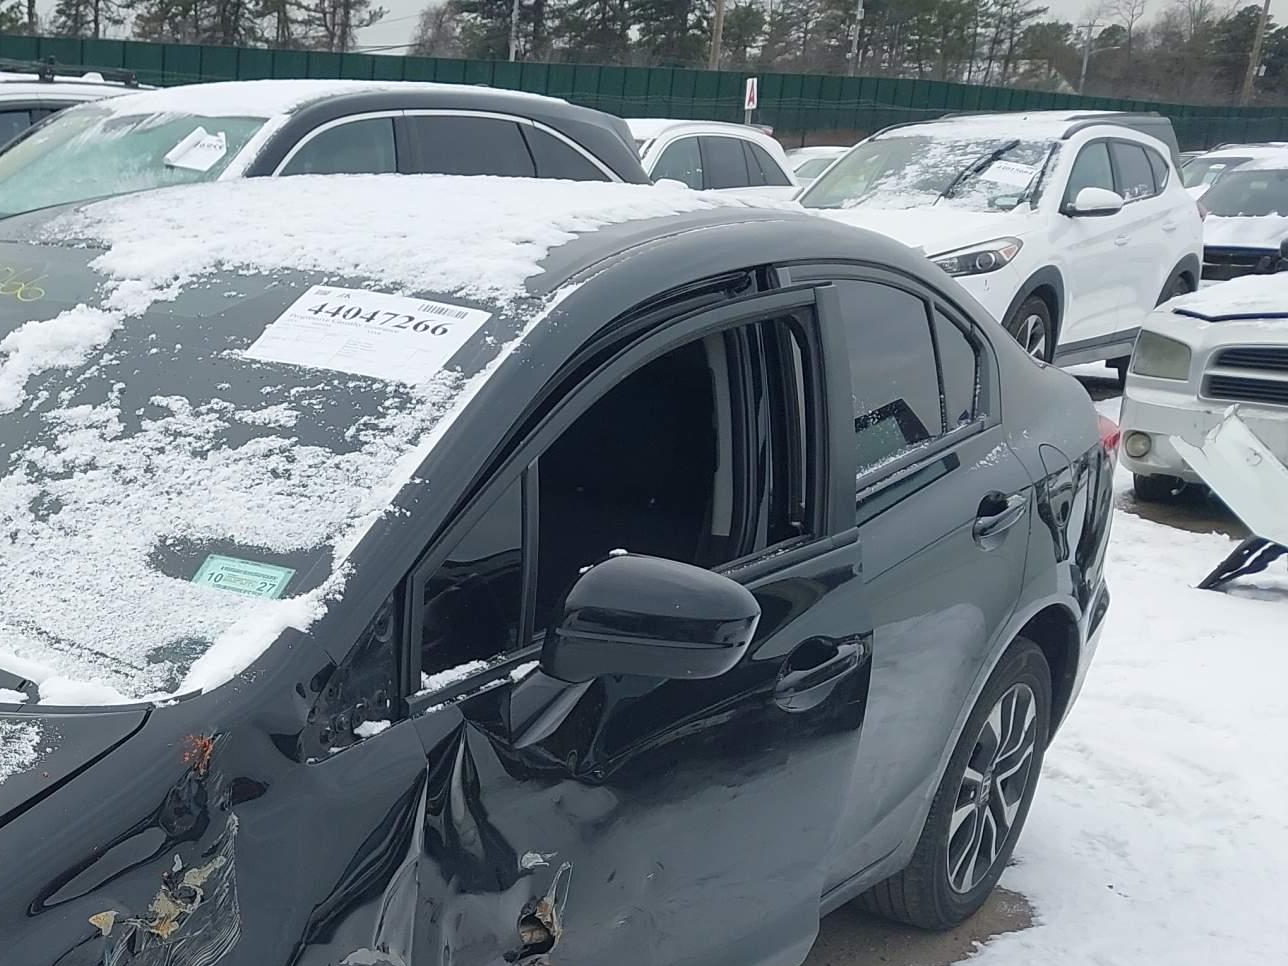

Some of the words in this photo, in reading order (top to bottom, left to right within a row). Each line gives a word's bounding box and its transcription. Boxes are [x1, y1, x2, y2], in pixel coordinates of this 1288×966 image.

[307, 301, 454, 336] 44047266
[207, 571, 224, 583] 10
[257, 581, 277, 593] 27
